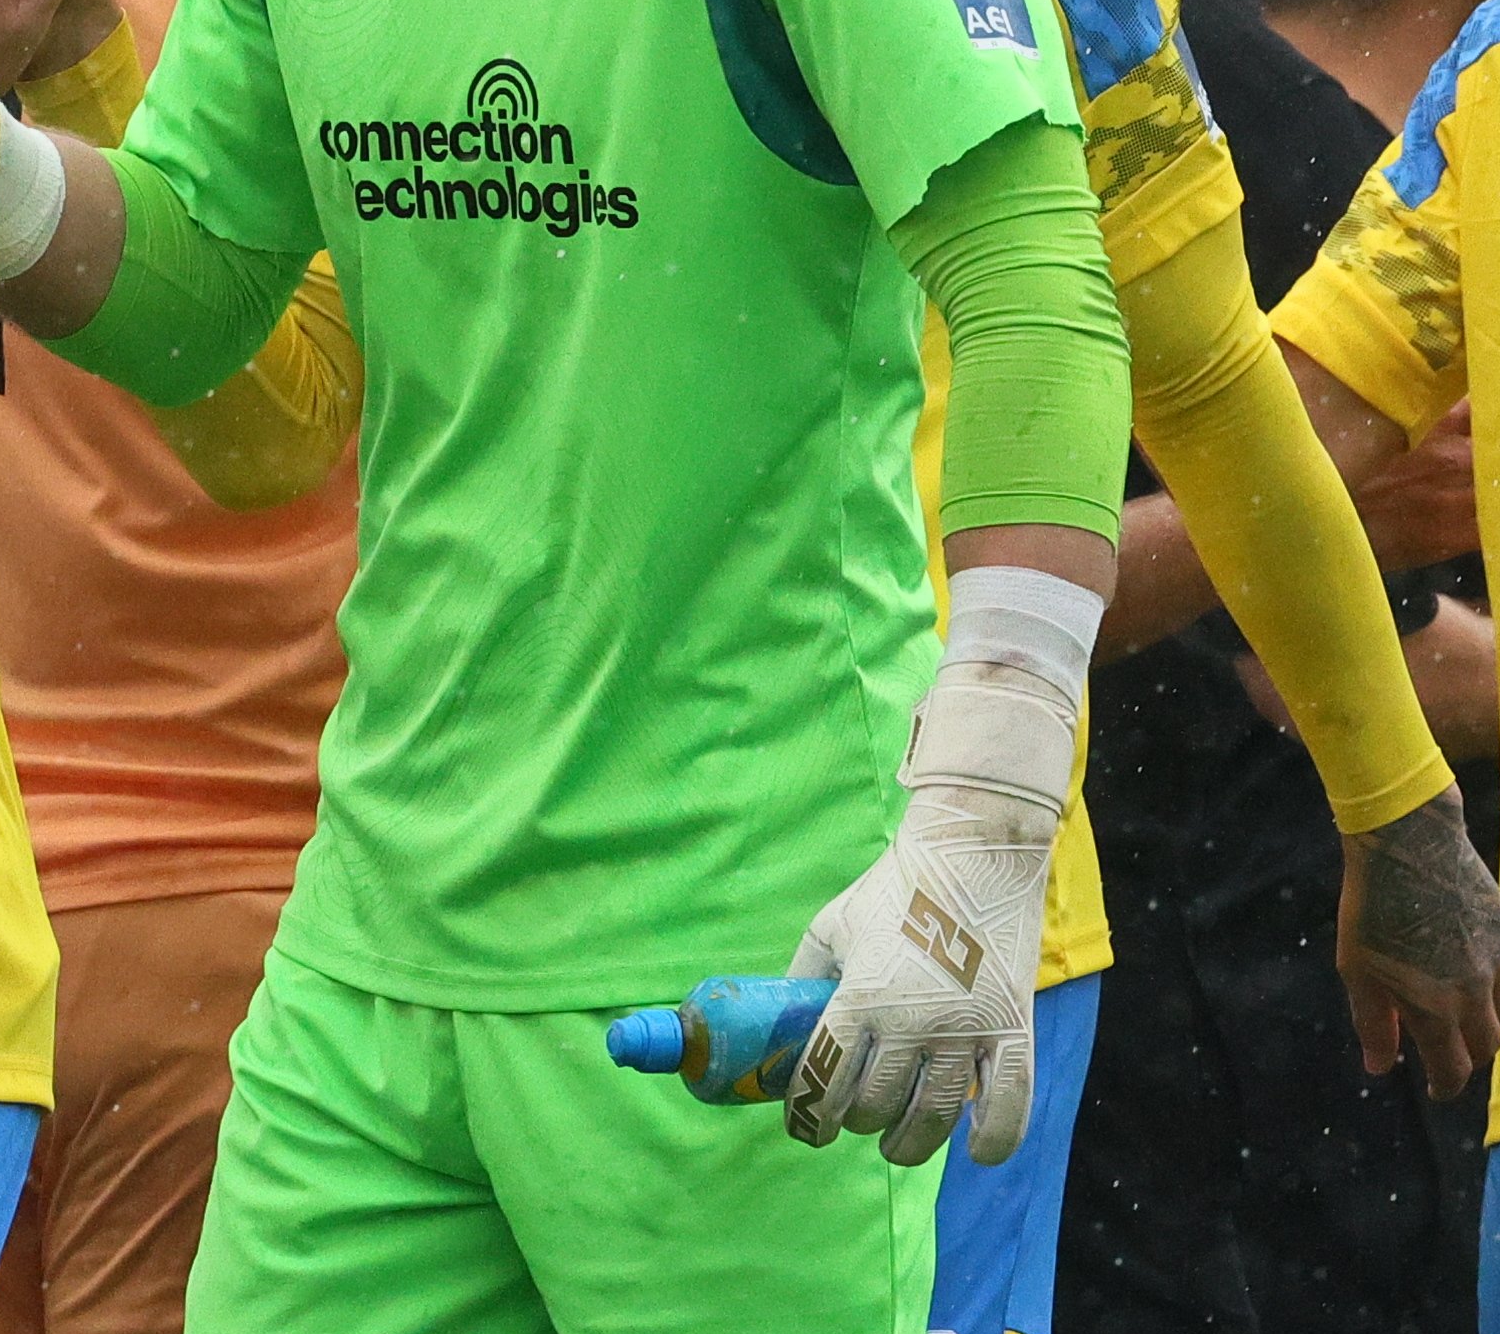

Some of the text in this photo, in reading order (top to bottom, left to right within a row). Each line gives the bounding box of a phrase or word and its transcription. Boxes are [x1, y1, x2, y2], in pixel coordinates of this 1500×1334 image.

[965, 5, 1015, 38] AEI
[319, 108, 575, 165] connection
[347, 165, 639, 238] echnologies
